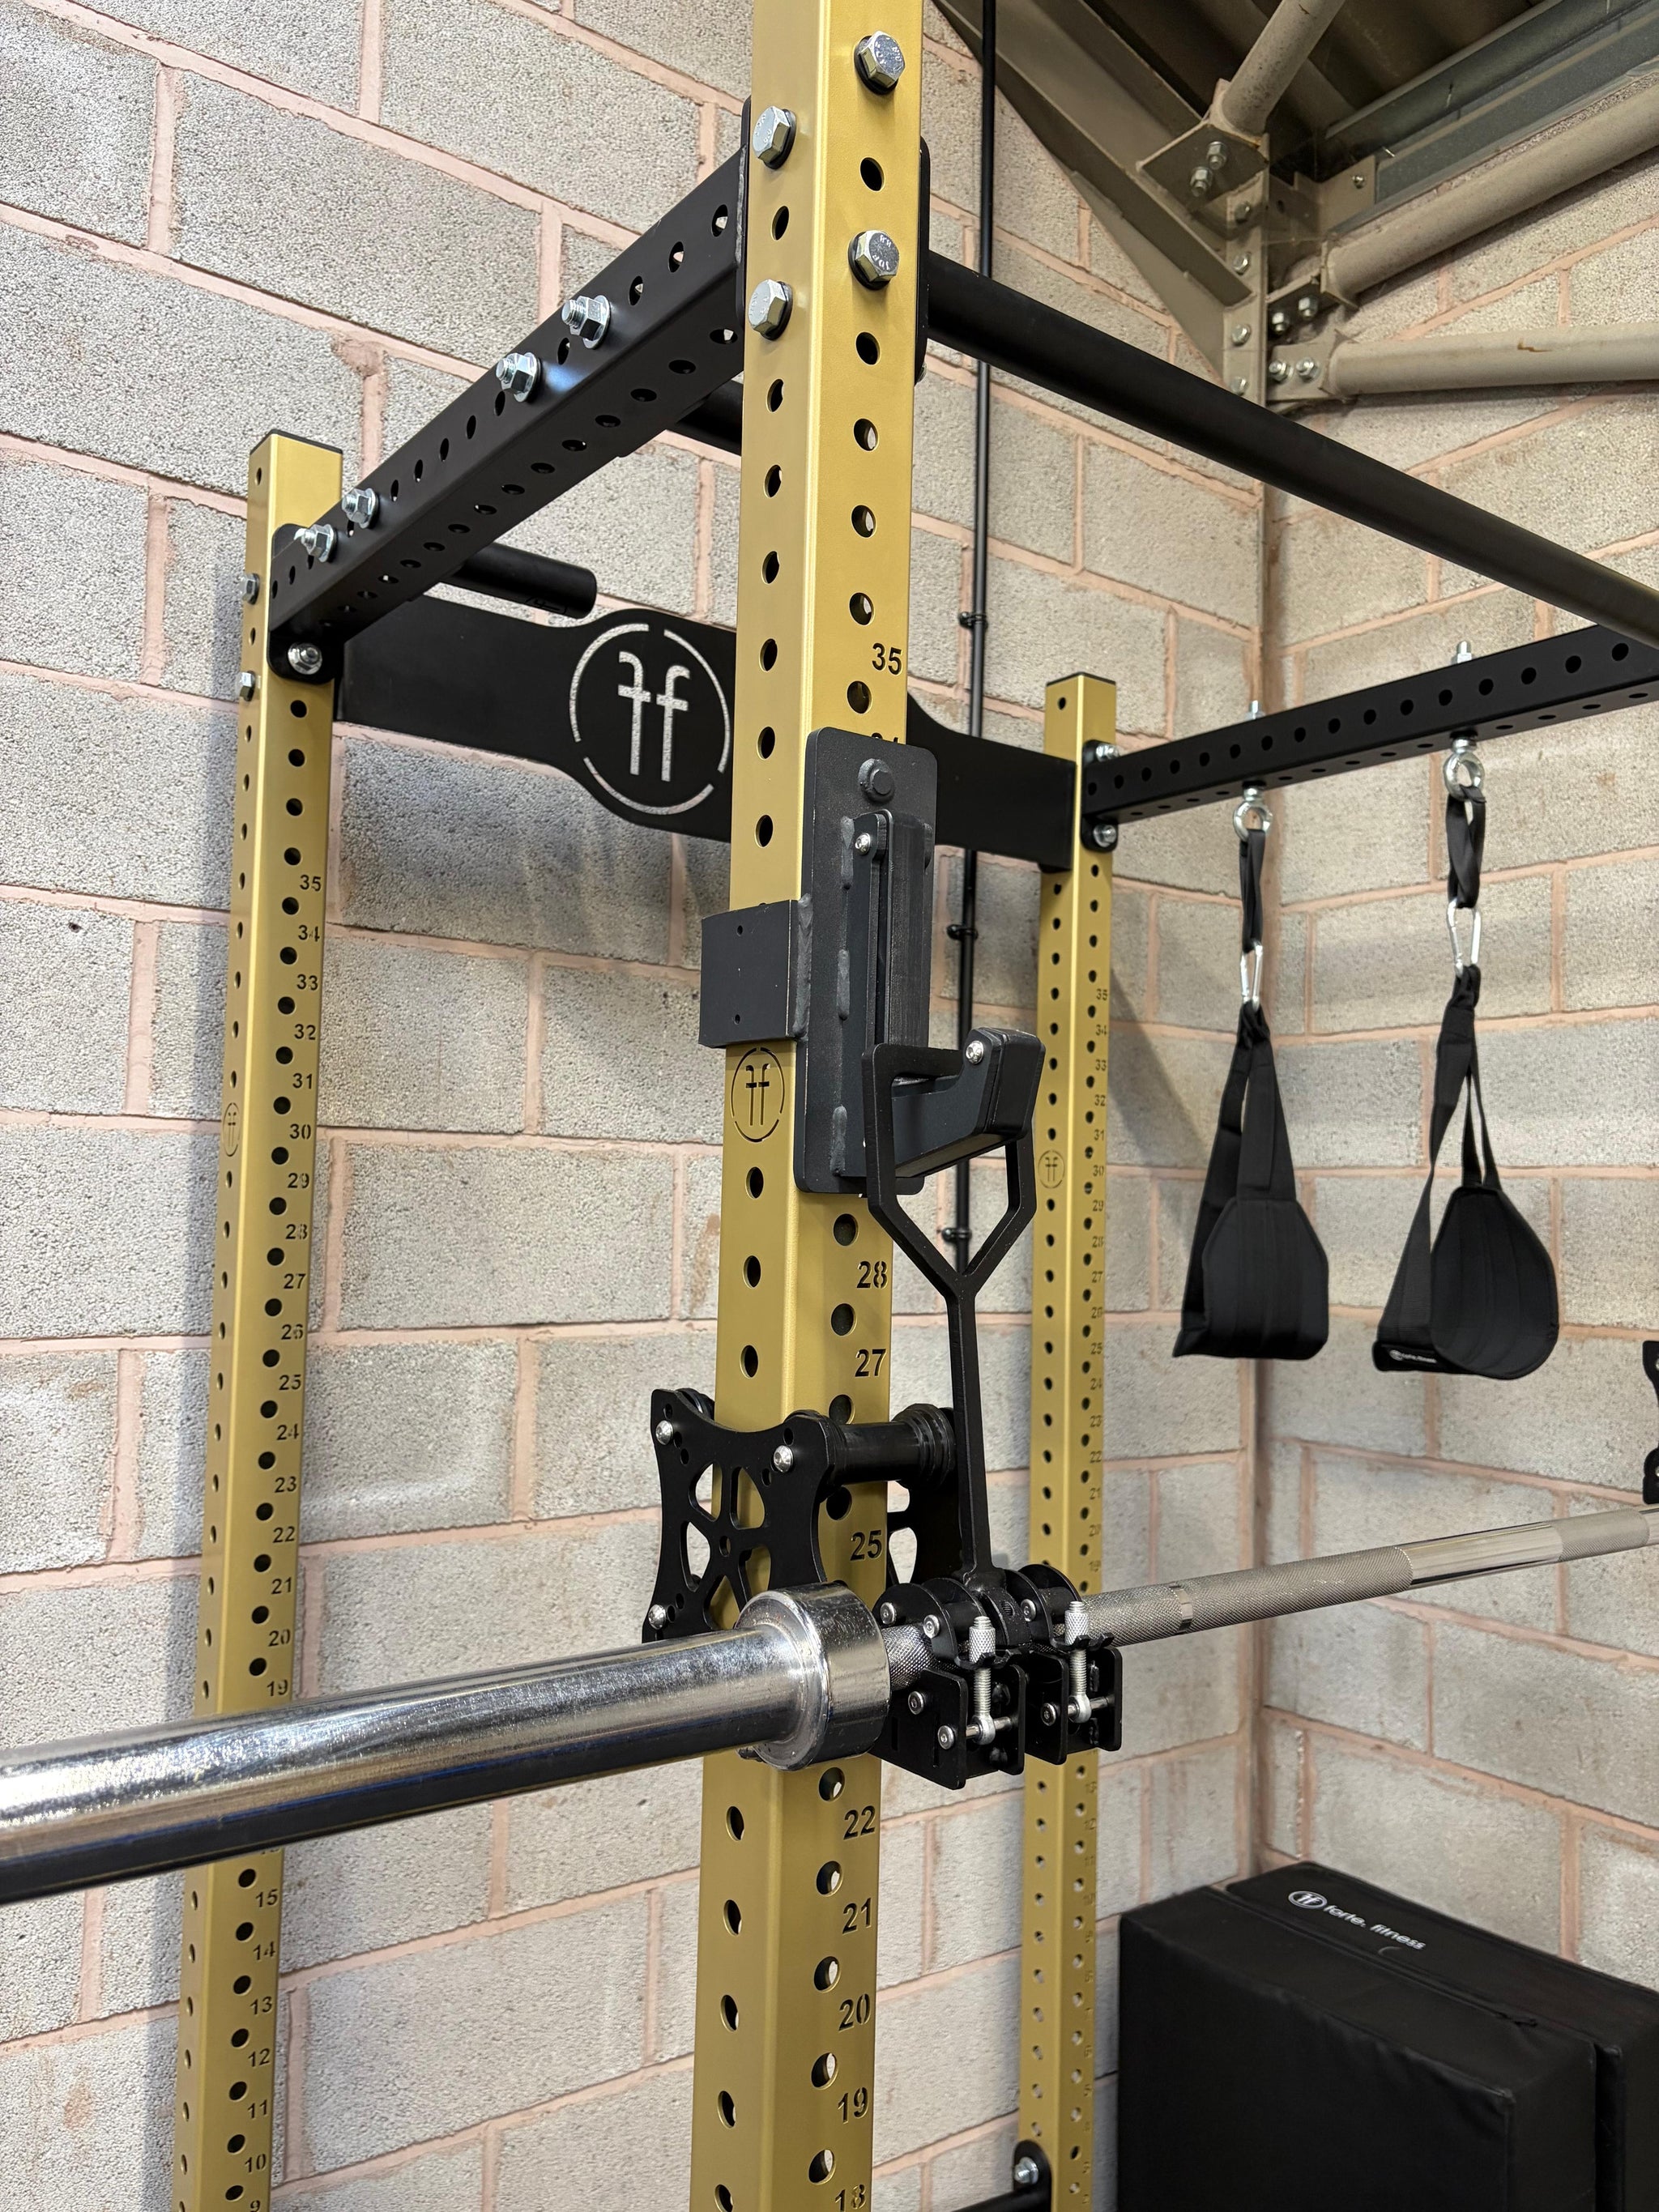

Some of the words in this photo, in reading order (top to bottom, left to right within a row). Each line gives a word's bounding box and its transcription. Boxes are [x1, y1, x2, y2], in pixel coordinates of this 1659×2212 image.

[872, 642, 902, 675] 35
[300, 875, 322, 892] 35
[298, 925, 320, 942] 34
[296, 974, 318, 991] 33
[294, 1024, 316, 1041] 32
[1095, 1025, 1107, 1036] 34
[1095, 1059, 1107, 1071] 33
[292, 1073, 313, 1089] 31
[1094, 1095, 1106, 1106] 32
[289, 1124, 311, 1140] 30
[1094, 1130, 1104, 1141] 31
[1093, 1165, 1104, 1176] 30
[288, 1173, 309, 1188] 29
[1093, 1200, 1104, 1212] 29
[285, 1224, 308, 1240] 28
[284, 1273, 306, 1289] 27
[856, 1260, 888, 1289] 28
[1091, 1271, 1103, 1283] 27
[281, 1324, 304, 1340] 26
[1090, 1342, 1102, 1355] 25
[855, 1349, 887, 1377] 27
[279, 1375, 301, 1390] 25
[277, 1424, 299, 1440] 24
[1090, 1451, 1102, 1463] 22
[275, 1476, 296, 1493] 23
[1090, 1487, 1101, 1500] 21
[272, 1526, 295, 1543] 22
[850, 1529, 882, 1561] 25
[271, 1577, 292, 1594] 21
[268, 1629, 290, 1647] 20
[267, 1679, 288, 1697] 19
[843, 1805, 876, 1840] 22
[255, 1889, 278, 1907] 15
[842, 1898, 872, 1934] 21
[1324, 1905, 1367, 1928] forte.
[1370, 1924, 1427, 1950] fitness
[253, 1941, 275, 1960] 14
[250, 1997, 272, 2014] 13
[838, 1993, 871, 2031] 20
[248, 2048, 270, 2067] 12
[248, 2099, 267, 2119] 11
[838, 2087, 868, 2124] 19
[245, 2154, 267, 2173] 10
[250, 2200, 261, 2212] 9
[835, 2184, 866, 2212] 18
